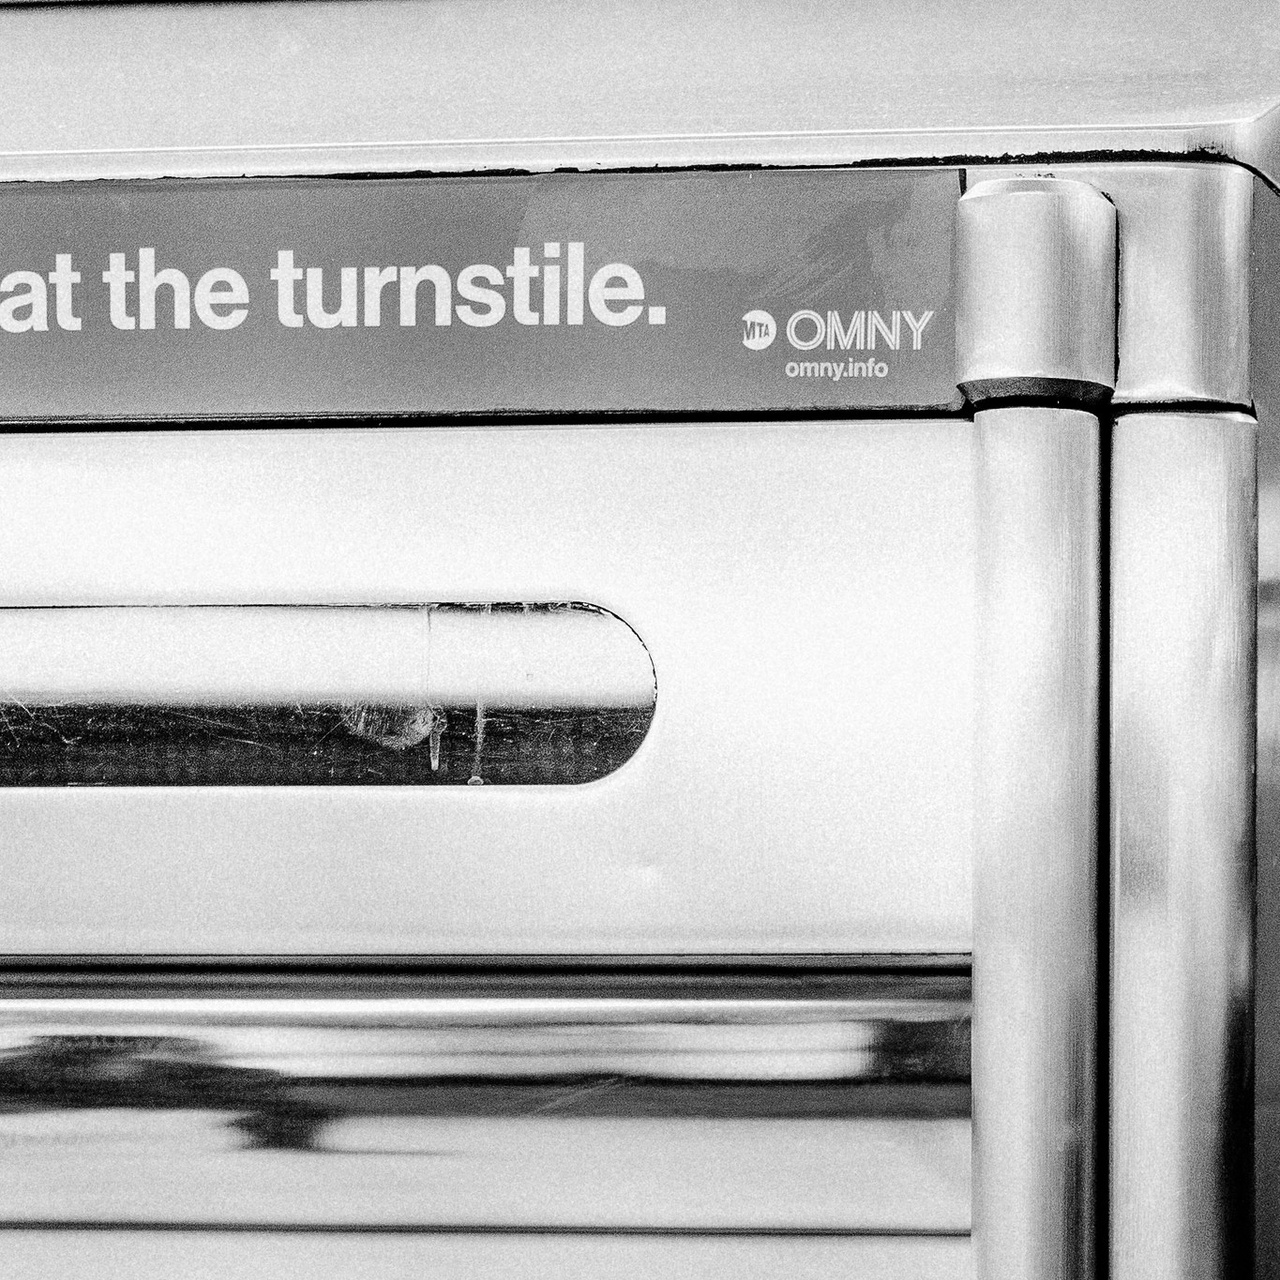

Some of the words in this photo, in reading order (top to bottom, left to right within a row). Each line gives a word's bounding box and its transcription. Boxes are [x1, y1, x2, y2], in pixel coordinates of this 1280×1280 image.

[0, 254, 81, 333] at
[103, 248, 249, 331] the
[271, 242, 667, 328] turnstile.
[786, 310, 934, 350] OMNY
[785, 358, 888, 381] omny.info
